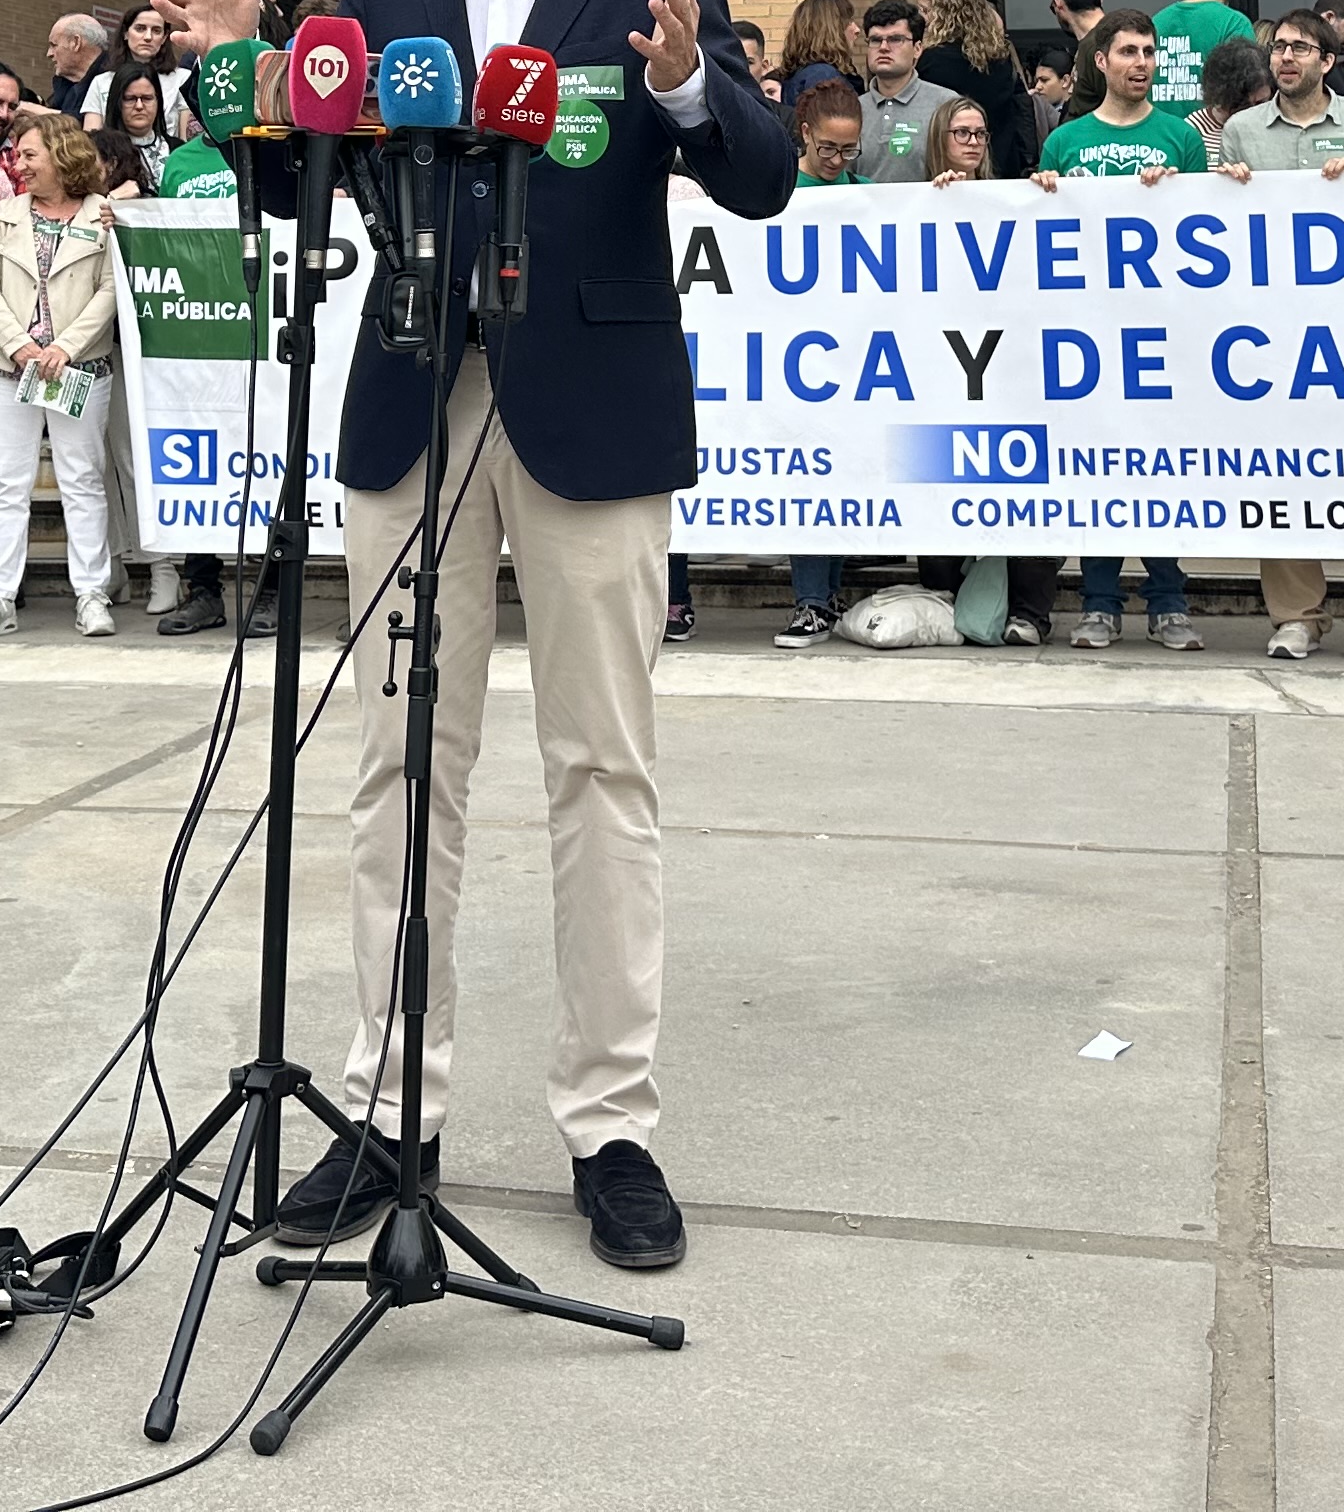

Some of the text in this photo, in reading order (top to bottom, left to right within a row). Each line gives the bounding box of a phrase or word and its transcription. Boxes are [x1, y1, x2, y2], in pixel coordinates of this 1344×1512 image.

[308, 57, 344, 79] 101
[507, 57, 548, 107] 7
[500, 107, 546, 125] siete
[556, 114, 603, 124] DUCACIÓN
[556, 123, 598, 134] PÚBLICA
[566, 143, 588, 152] PSOE
[128, 266, 185, 295] MA
[162, 296, 252, 321] PÚBLICA
[683, 330, 916, 403] LICA
[942, 329, 1004, 401] Y
[1042, 327, 1173, 402] DE
[160, 433, 210, 480] SI
[951, 430, 1038, 478] NO
[158, 491, 272, 528] UNIÓN
[677, 497, 903, 527] VERSITARIA
[951, 498, 1227, 530] COMPLICIDAD
[1240, 500, 1291, 530] DE
